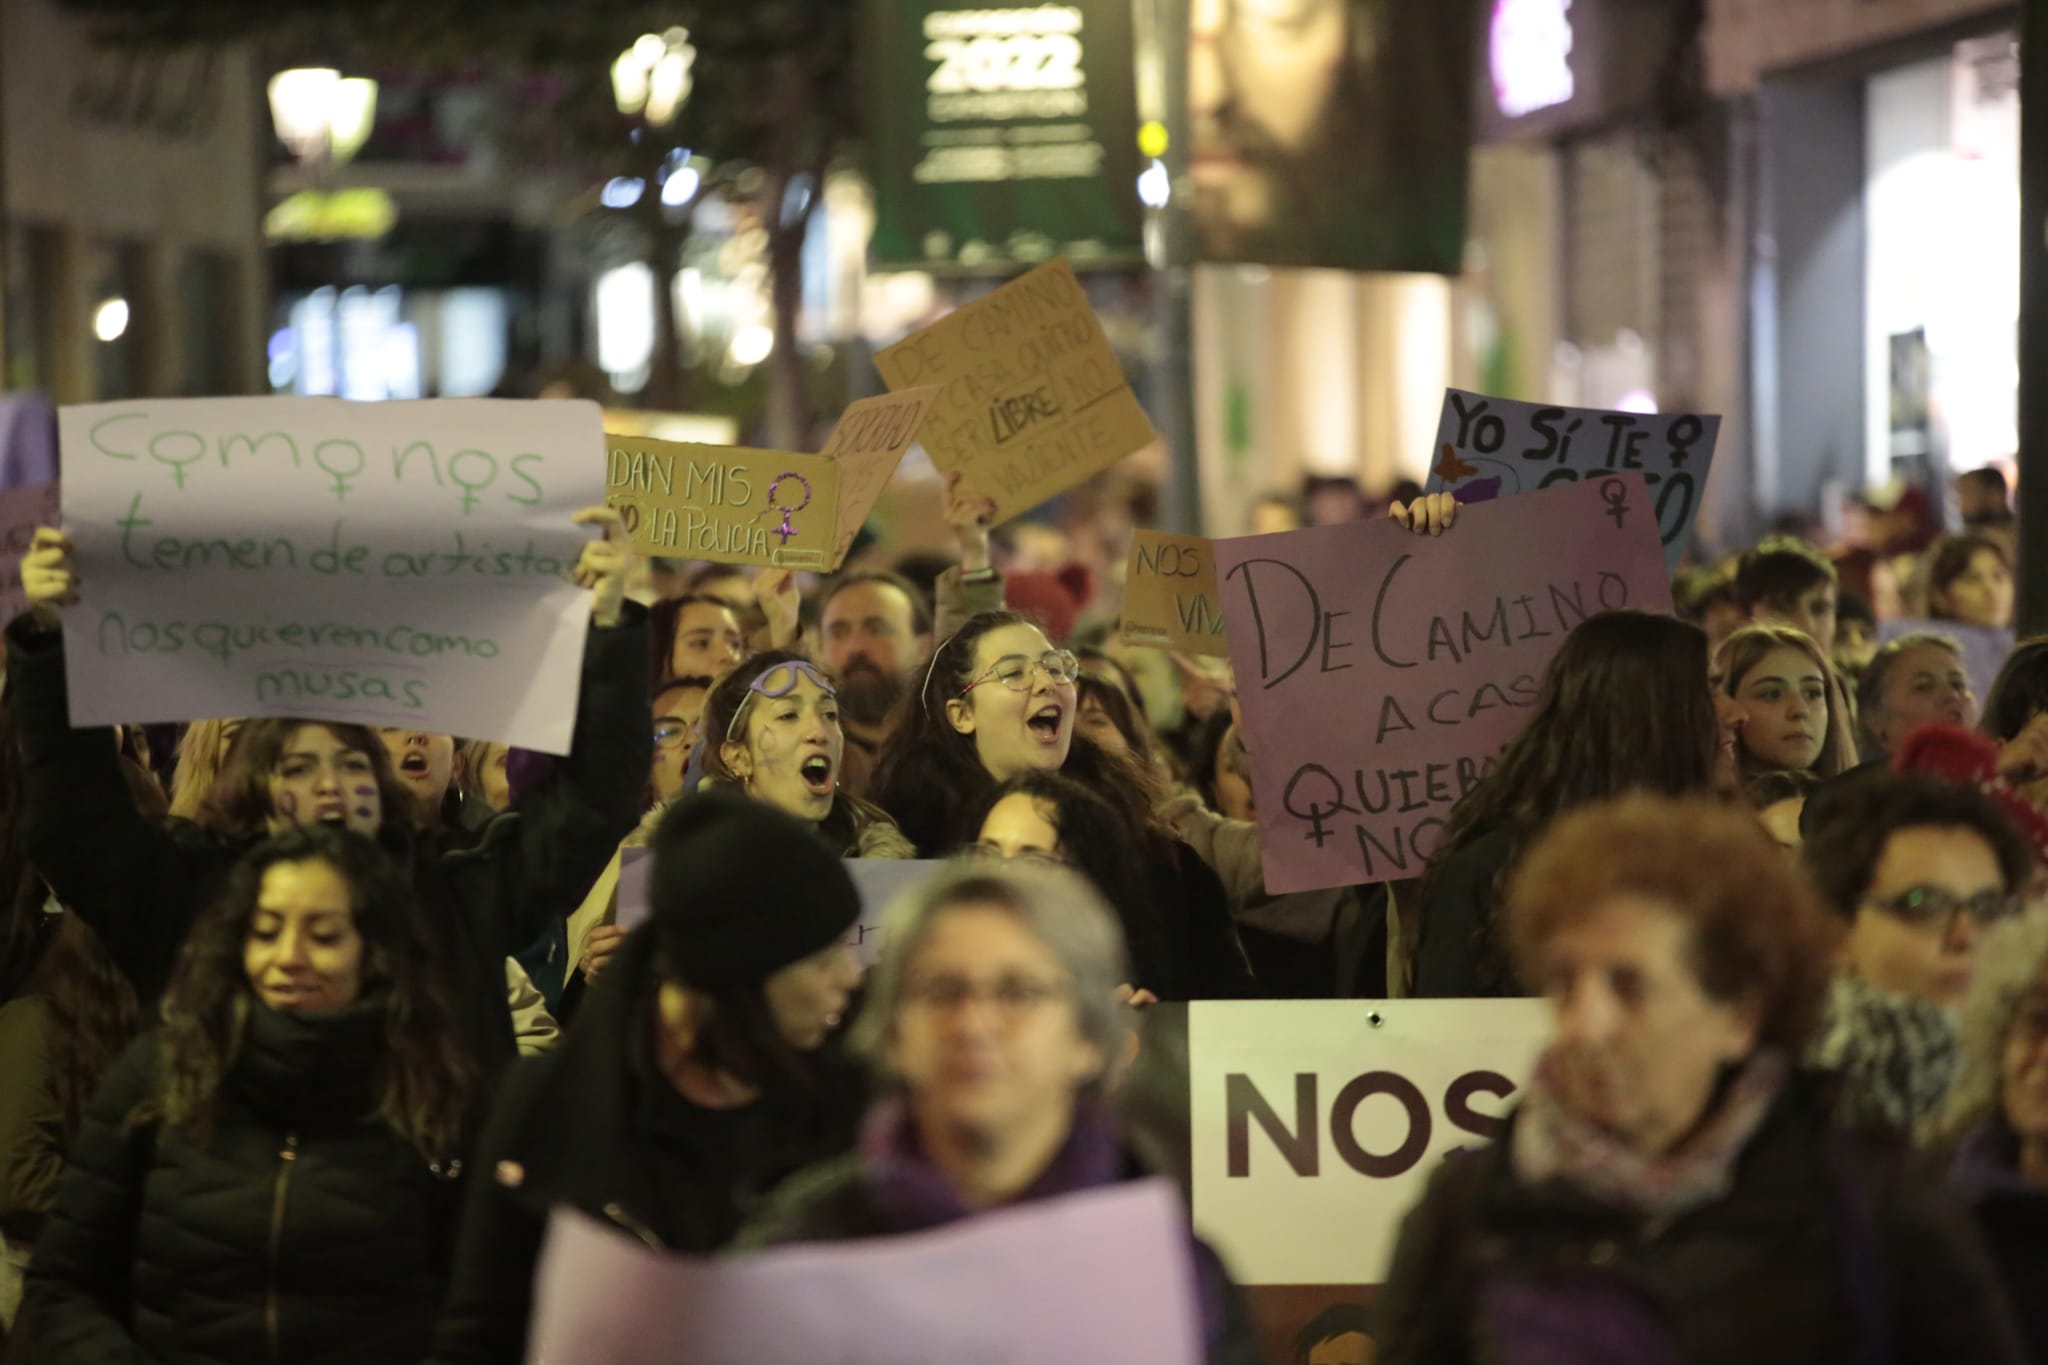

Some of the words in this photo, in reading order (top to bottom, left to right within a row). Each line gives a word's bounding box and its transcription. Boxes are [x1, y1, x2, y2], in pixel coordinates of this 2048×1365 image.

[891, 333, 946, 385] DE
[961, 267, 1077, 351] CAMINO
[606, 447, 675, 496] DAN
[686, 460, 752, 506] MIS
[118, 492, 296, 571] temen
[310, 519, 369, 575] de
[651, 507, 677, 547] LA
[1136, 543, 1201, 578] NOS
[256, 667, 428, 709] musas
[1375, 694, 1416, 745] A
[1426, 673, 1543, 725] CAS
